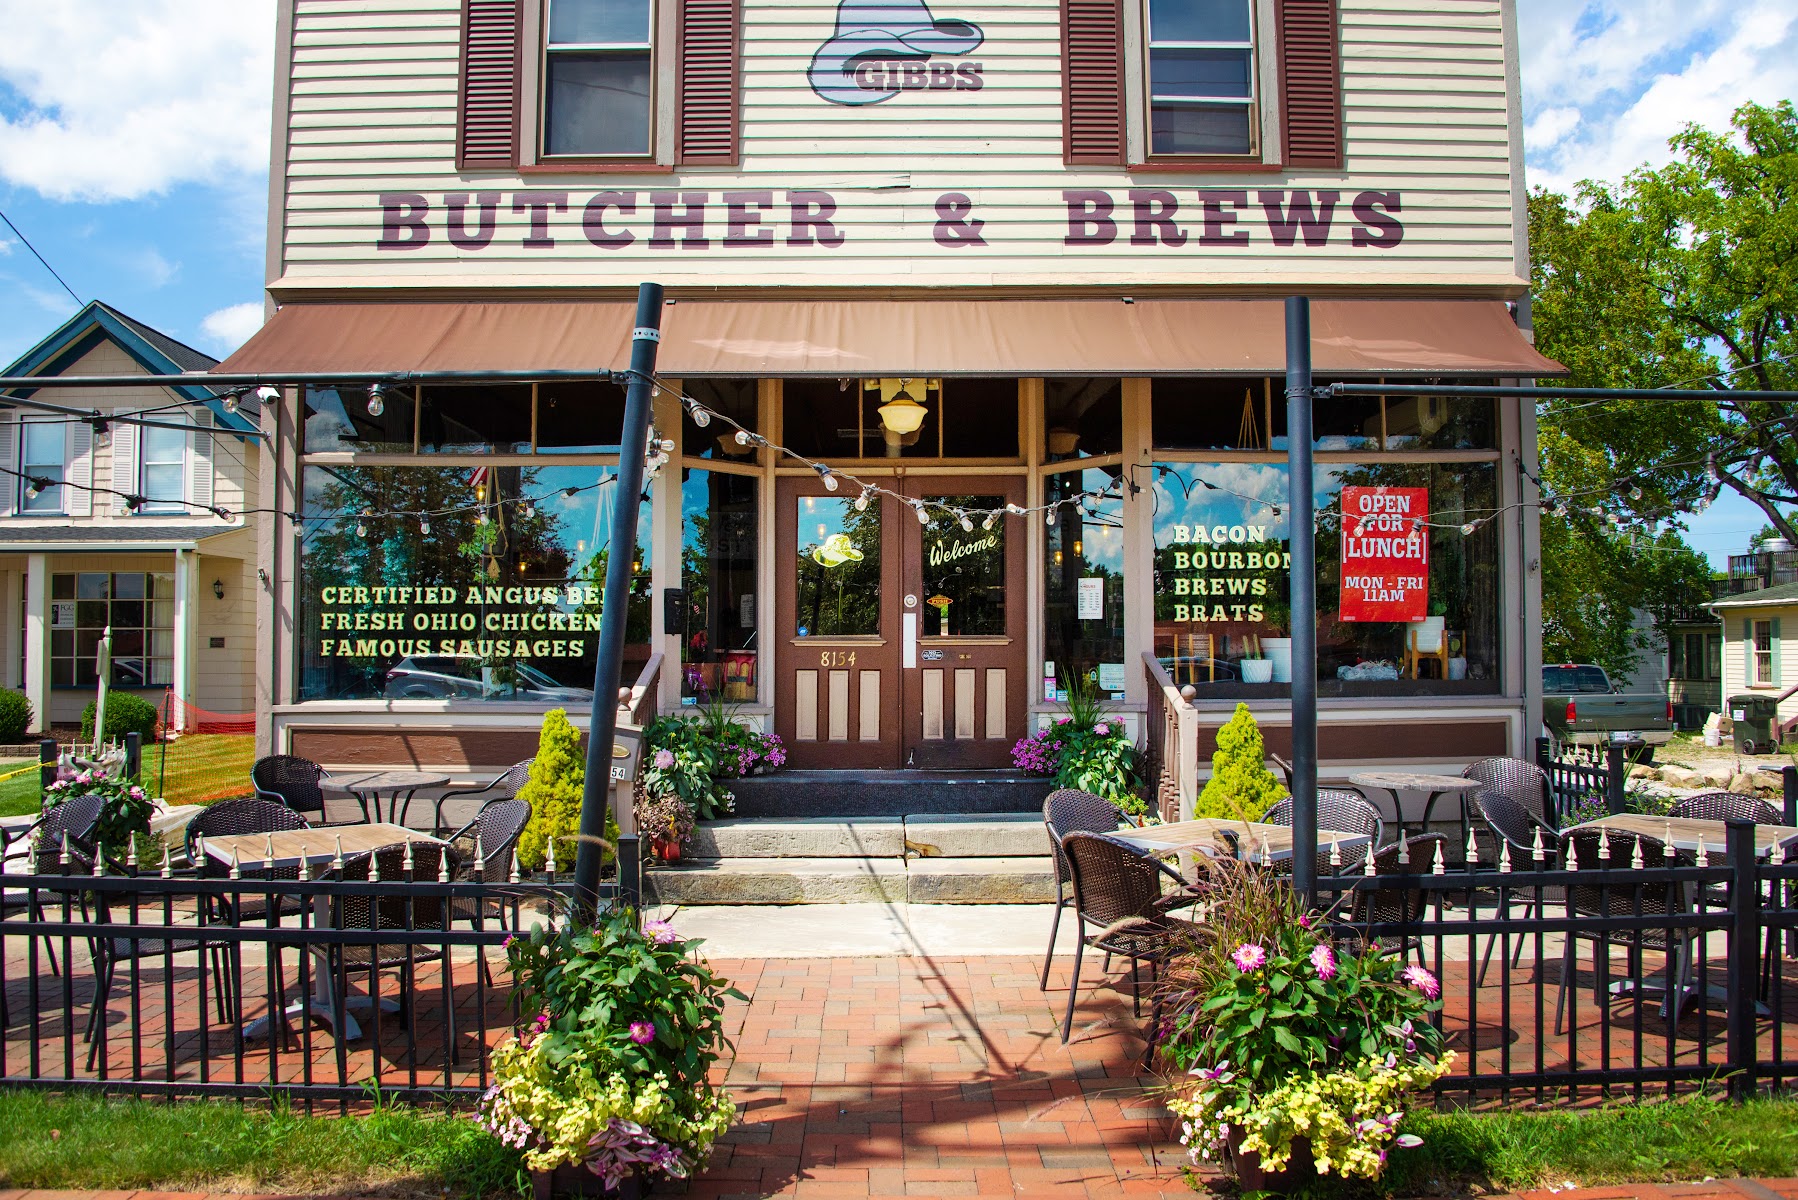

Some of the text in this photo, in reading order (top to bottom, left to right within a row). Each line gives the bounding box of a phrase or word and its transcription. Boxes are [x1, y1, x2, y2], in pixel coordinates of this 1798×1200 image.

[855, 61, 984, 91] GIBBS
[377, 189, 1405, 251] BUTCHER & BREWS
[1359, 494, 1411, 513] OPEN
[1366, 513, 1404, 532] FOR
[1173, 525, 1266, 543] BACON
[929, 535, 998, 567] Welcome
[1174, 578, 1267, 596] BREWS
[1345, 576, 1383, 589] MON
[1397, 577, 1424, 590] FRI
[321, 587, 606, 605] CERTIFIED ANGUS BE
[1363, 589, 1405, 602] 11AM
[321, 613, 602, 631] FRESH OHIO CHICKEN
[1174, 604, 1264, 622] BRATS
[321, 640, 584, 657] FAMOUS SAUSAGES
[820, 651, 856, 667] 8154
[612, 768, 624, 778] 54
